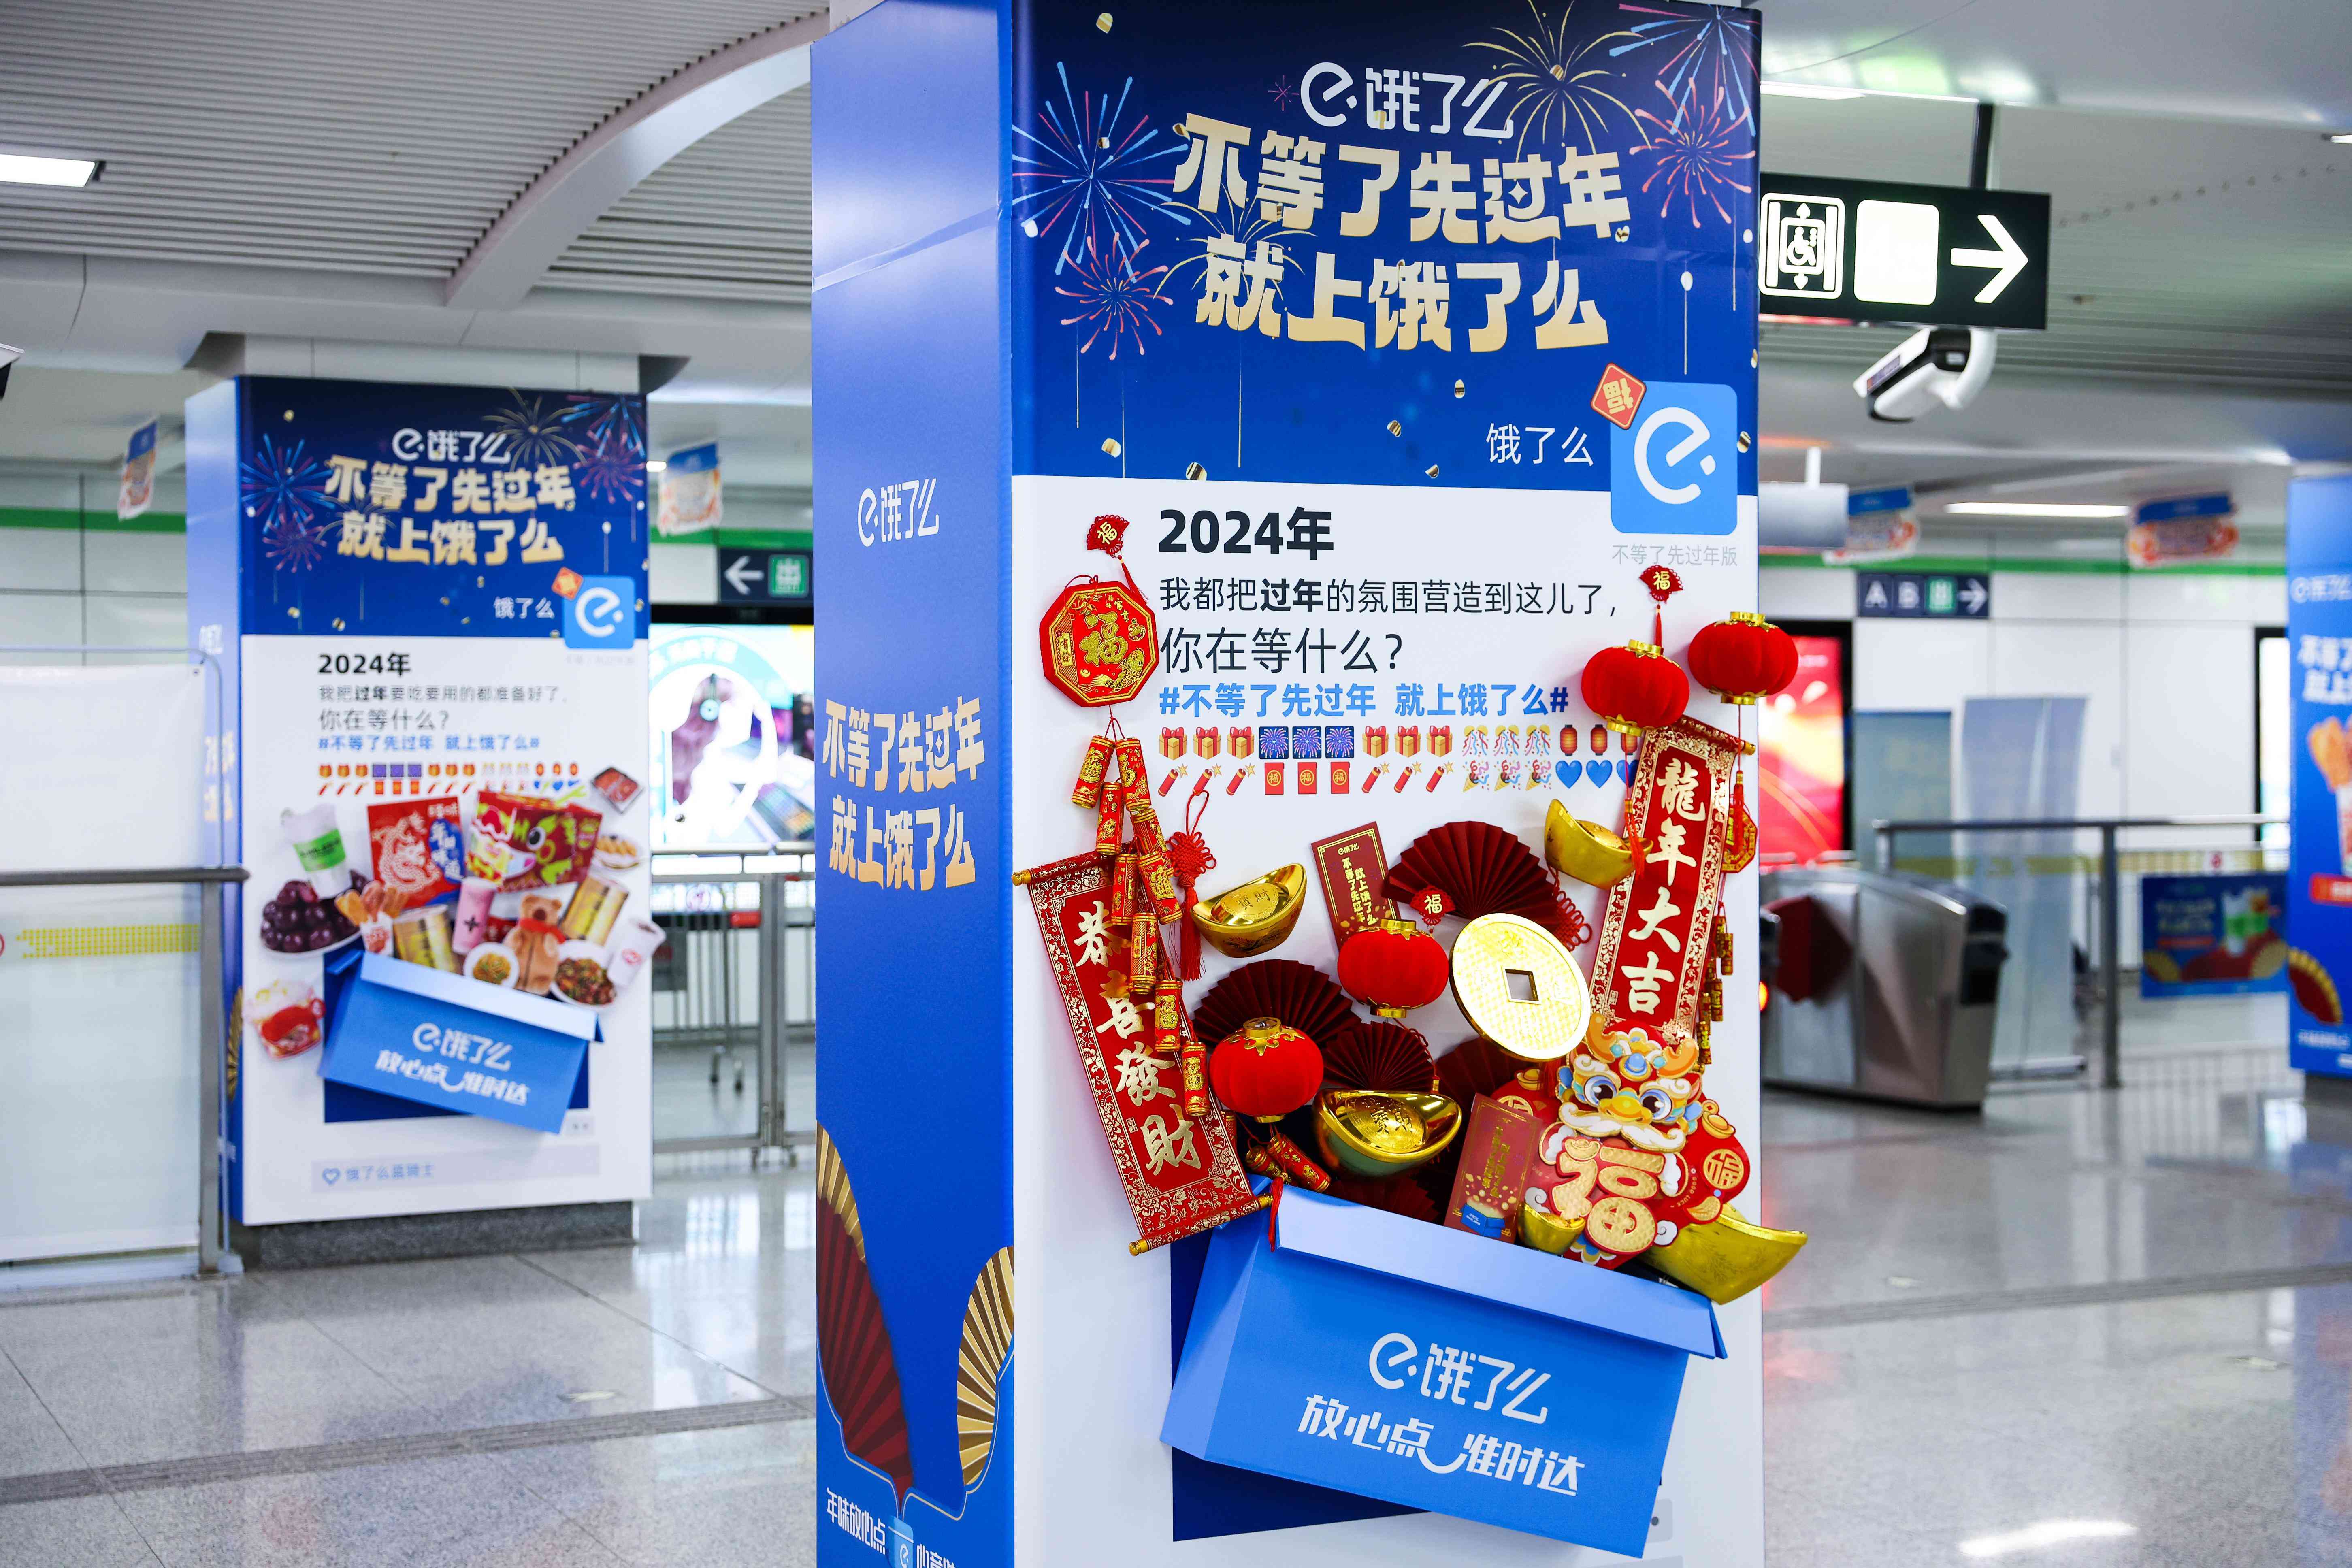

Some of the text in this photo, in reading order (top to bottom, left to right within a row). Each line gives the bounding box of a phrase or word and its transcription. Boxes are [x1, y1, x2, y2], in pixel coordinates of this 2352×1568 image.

[1172, 112, 1630, 244] 不等了先过年
[1196, 233, 1609, 353] 就上饿了么
[1486, 422, 1594, 467] 饿了么
[325, 453, 575, 514] 不等了先过年
[337, 511, 564, 566] 就上饿了么
[1097, 522, 1117, 544] 福
[1159, 507, 1334, 561] 2024年
[1612, 544, 1738, 566] 不等了先过年版
[1653, 571, 1670, 590] 福
[1865, 580, 1919, 609] A B
[493, 597, 554, 620] 饿了么
[318, 653, 411, 677] 2024年
[1160, 627, 1404, 675] 你在等什么？
[1159, 683, 1569, 719] #不等了先过年 就上饿了么#
[318, 735, 540, 752] #不等了先过年 就上饿了么#
[822, 695, 986, 794] 不等了先过年
[829, 793, 976, 891] 就上饿了么
[1342, 857, 1365, 922] 不等了先过年
[1354, 868, 1377, 925] 就上饿了么
[1424, 894, 1443, 914] 福
[1621, 758, 1706, 1015] 龍年大吉
[827, 1487, 886, 1555] 年味放心点
